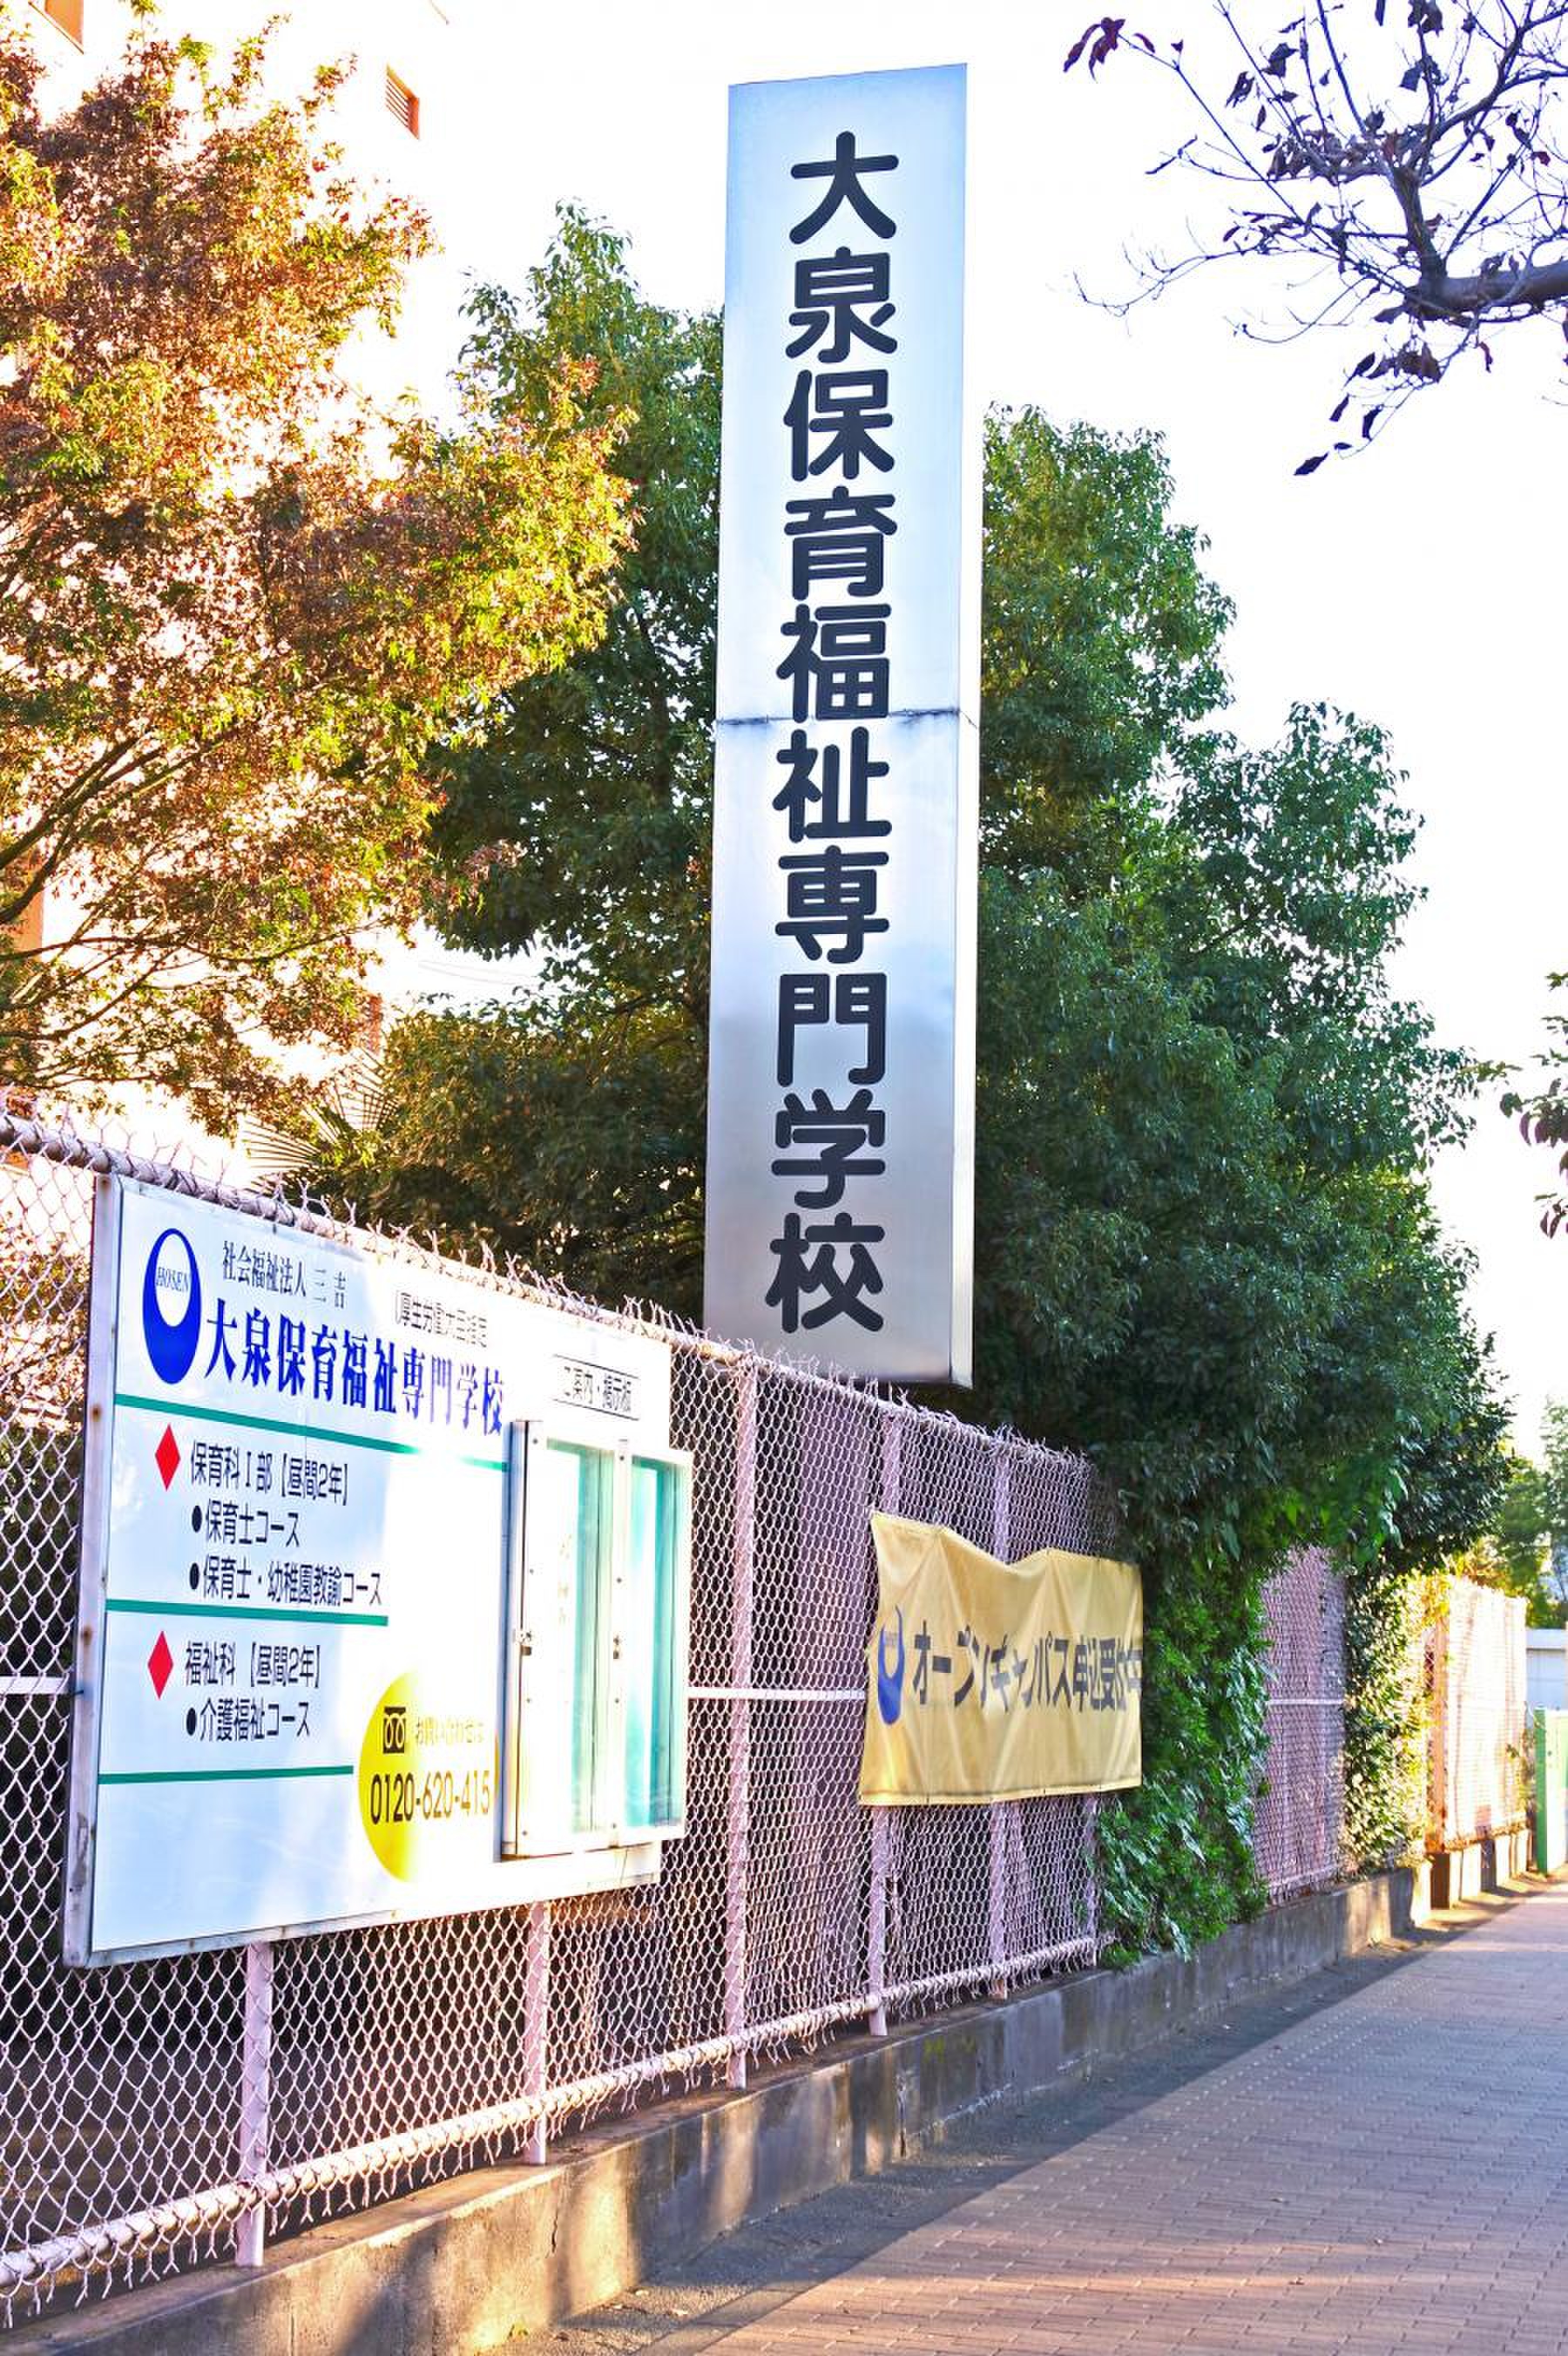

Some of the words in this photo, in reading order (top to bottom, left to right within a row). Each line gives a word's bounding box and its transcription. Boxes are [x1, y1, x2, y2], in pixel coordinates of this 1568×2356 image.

[765, 130, 900, 1334] 大泉保育福祉専門学校
[221, 1240, 307, 1298] 社会福祉法人
[205, 1297, 504, 1436] 大泉保育福祉専門学校
